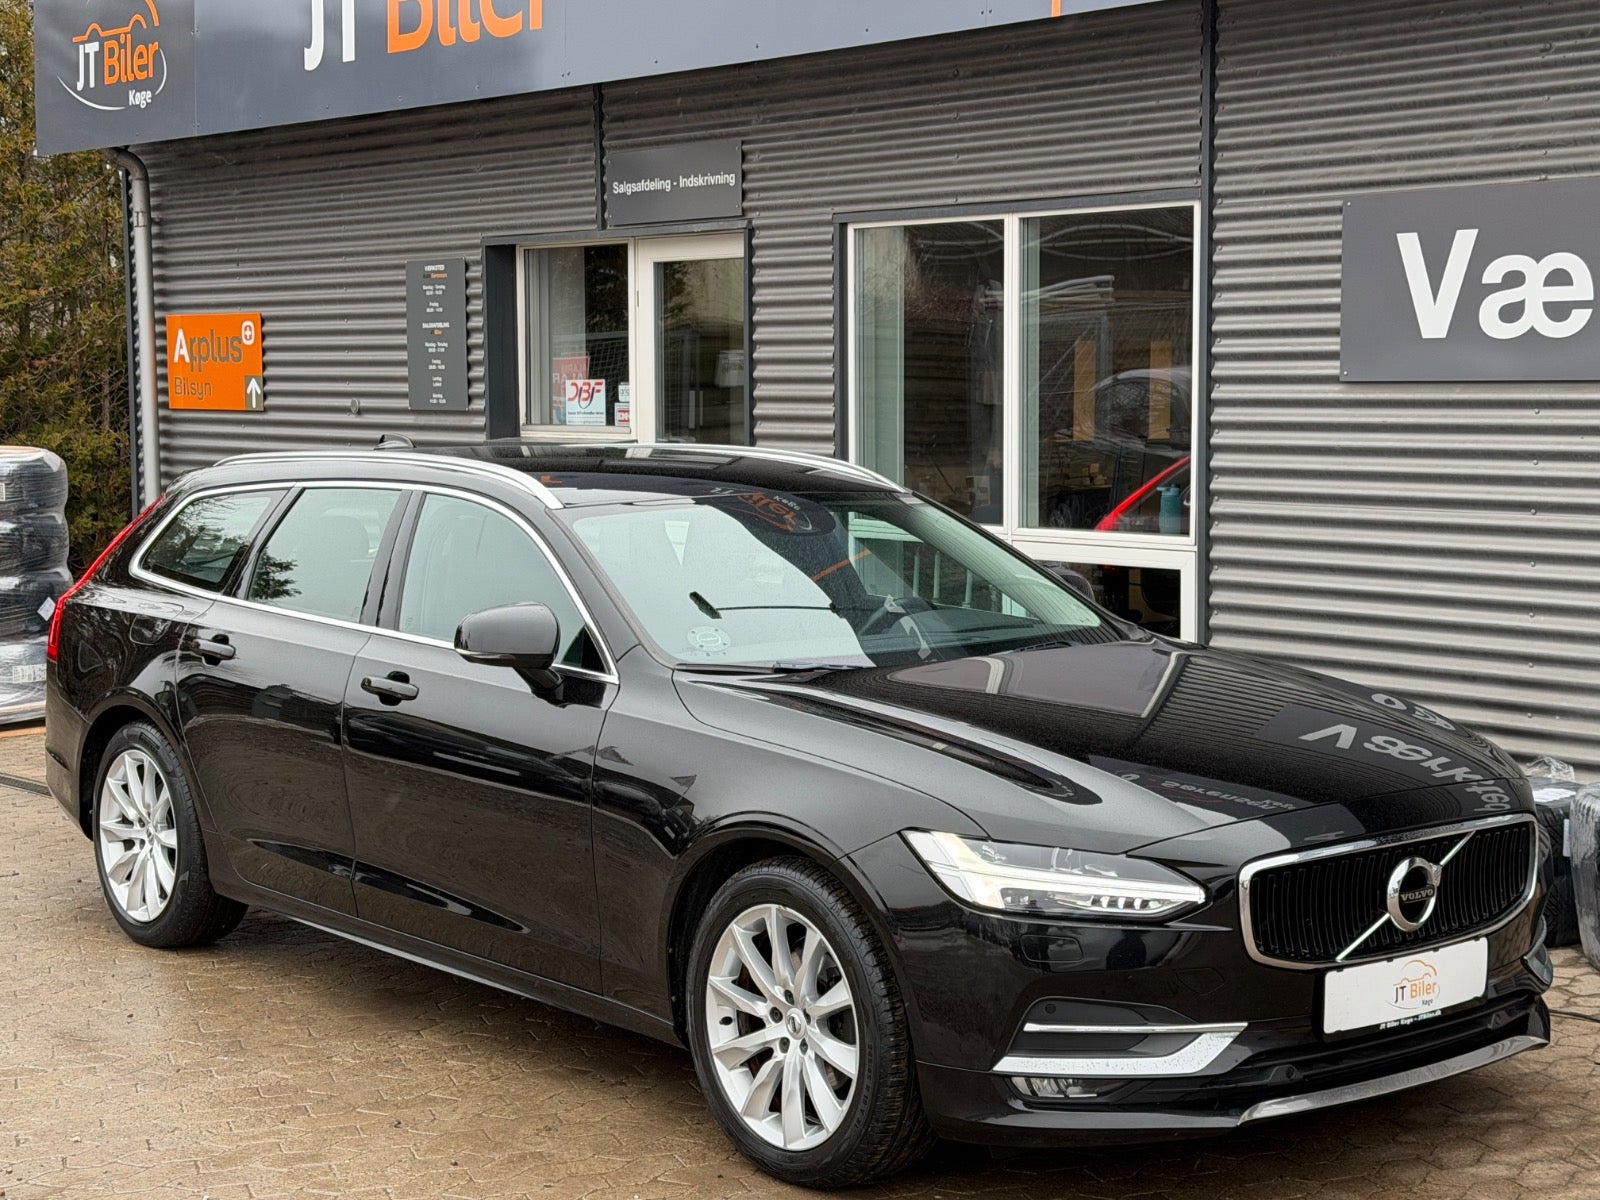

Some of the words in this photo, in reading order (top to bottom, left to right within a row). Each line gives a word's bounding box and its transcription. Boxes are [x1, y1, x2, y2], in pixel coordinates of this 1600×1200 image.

[77, 41, 99, 91] JT
[104, 33, 159, 85] Biler
[128, 89, 152, 109] Køge
[613, 178, 671, 195] Salgsafdeling
[679, 172, 736, 188] Indskrivning
[1396, 228, 1594, 340] Væ
[174, 376, 212, 401] Bilsyn
[1400, 888, 1433, 901] VOLVO
[1394, 985, 1406, 1004] JT
[1410, 980, 1437, 999] Biler
